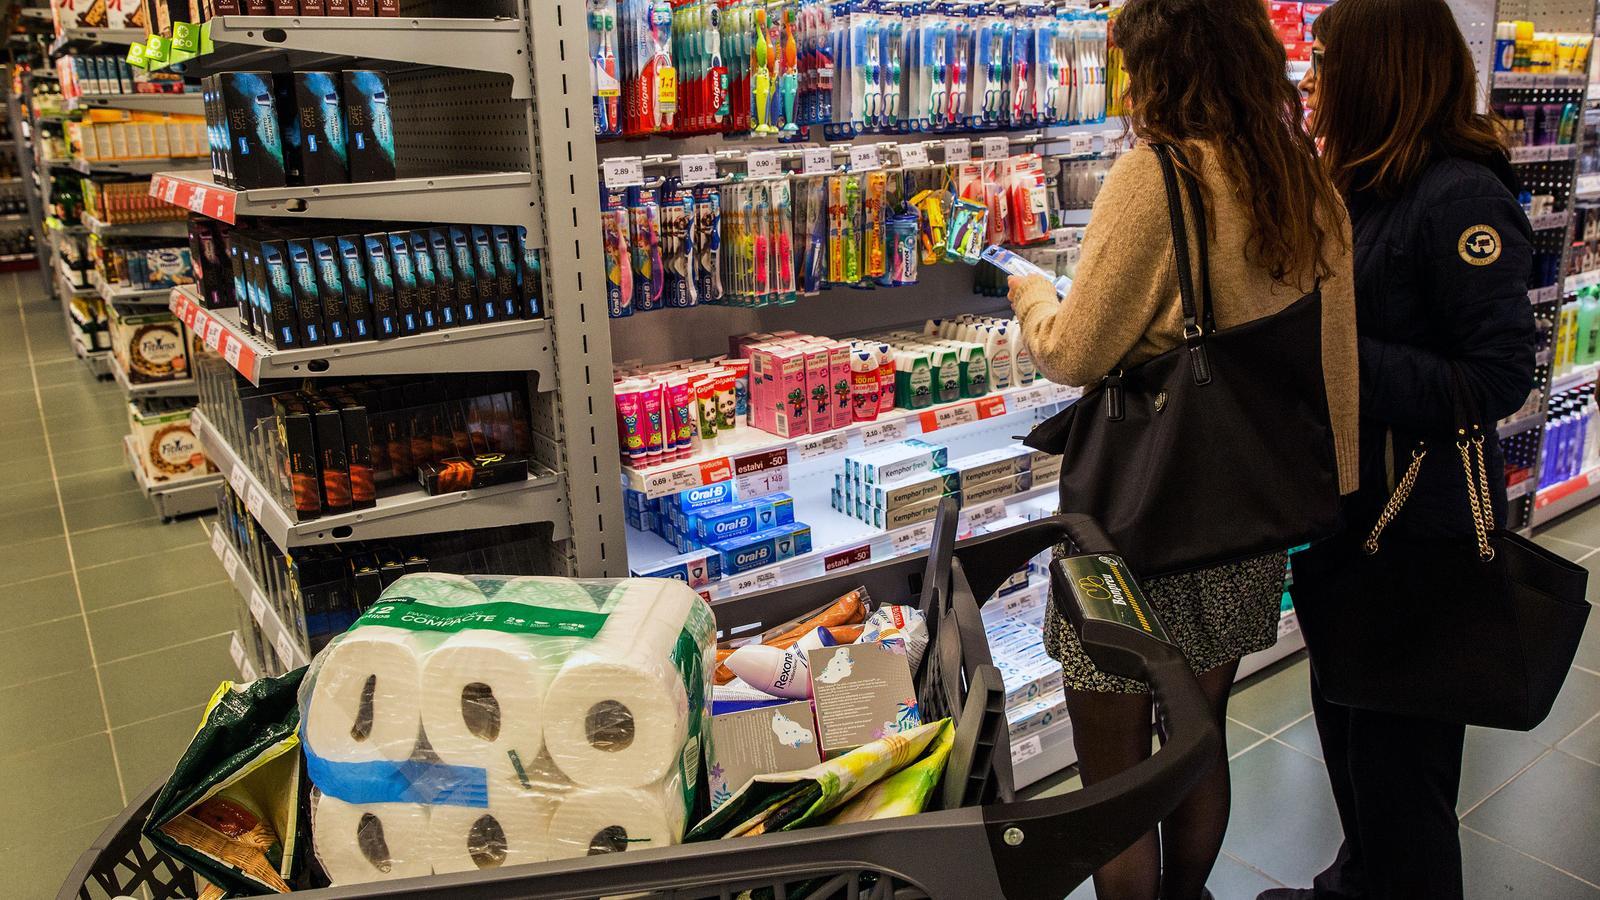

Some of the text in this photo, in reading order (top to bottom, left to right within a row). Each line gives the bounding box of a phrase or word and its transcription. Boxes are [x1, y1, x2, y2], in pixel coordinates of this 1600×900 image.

[738, 461, 764, 473] estalvi
[886, 460, 927, 478] Kemphor fresh
[966, 464, 1012, 480] Kemphor original
[652, 478, 667, 486] 0,69
[690, 484, 723, 500] Oral-B
[894, 485, 937, 501] Kemphor fresh
[967, 484, 1012, 500] Kemphor original
[894, 510, 922, 522] Kemphor
[716, 517, 748, 533] Oral-B
[737, 548, 768, 564] Oral-B
[827, 557, 849, 569] estalvi
[738, 581, 752, 589] 2,99
[1102, 574, 1127, 606] Bonpreu
[368, 606, 395, 614] 12
[400, 614, 497, 627] COMPACTE
[774, 652, 793, 689] Rexona
